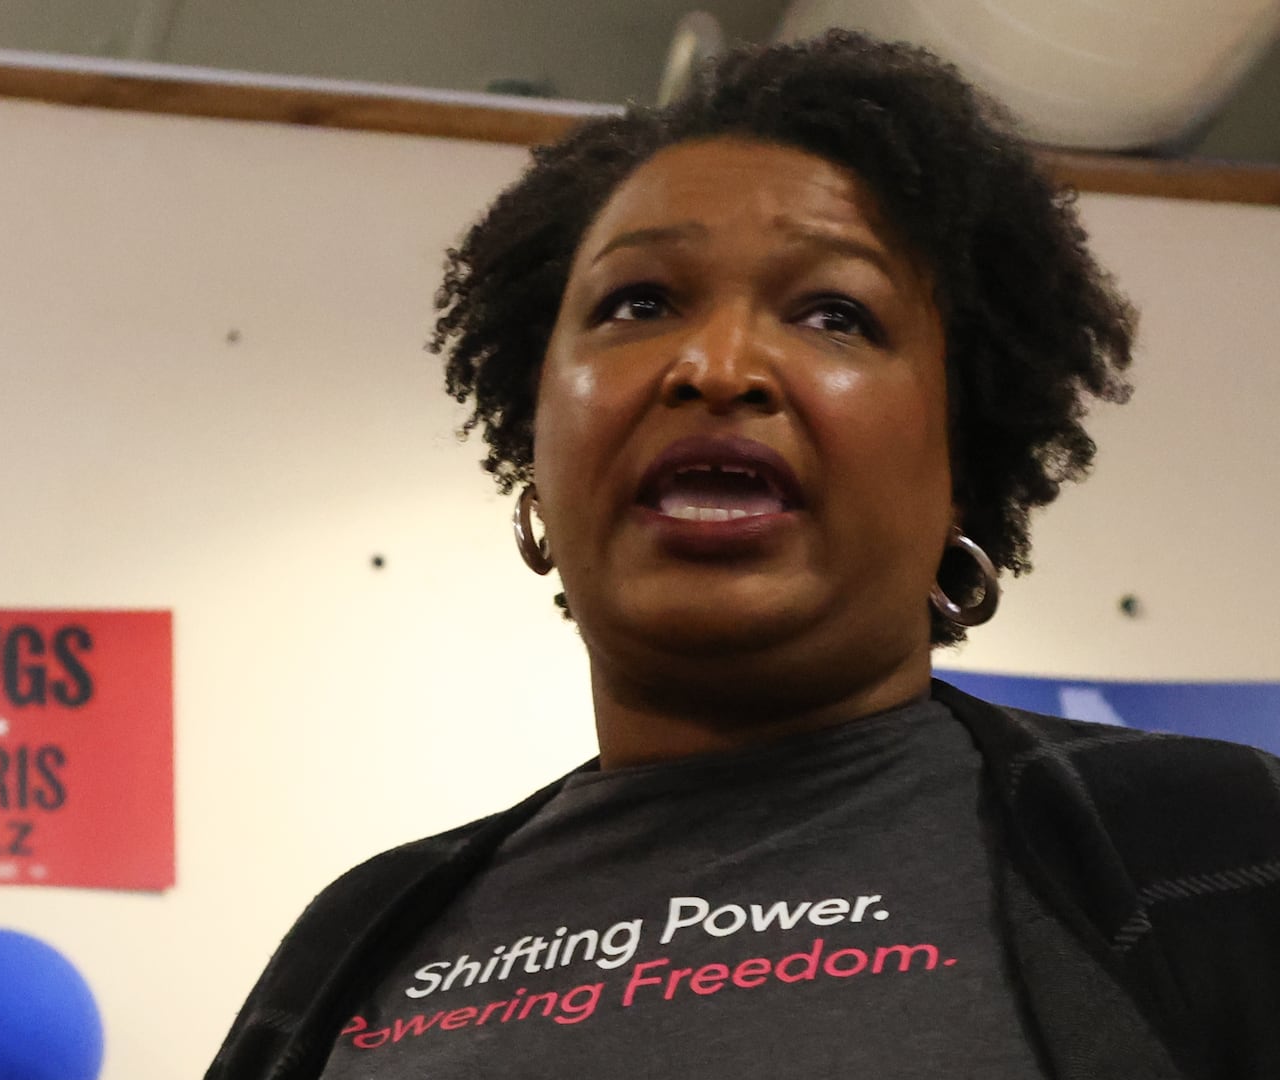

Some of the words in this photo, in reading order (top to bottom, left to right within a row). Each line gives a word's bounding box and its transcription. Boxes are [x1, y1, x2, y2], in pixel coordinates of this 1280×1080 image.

[405, 918, 643, 998] Shifting
[660, 893, 890, 945] Power.
[622, 938, 957, 1007] Freedom.
